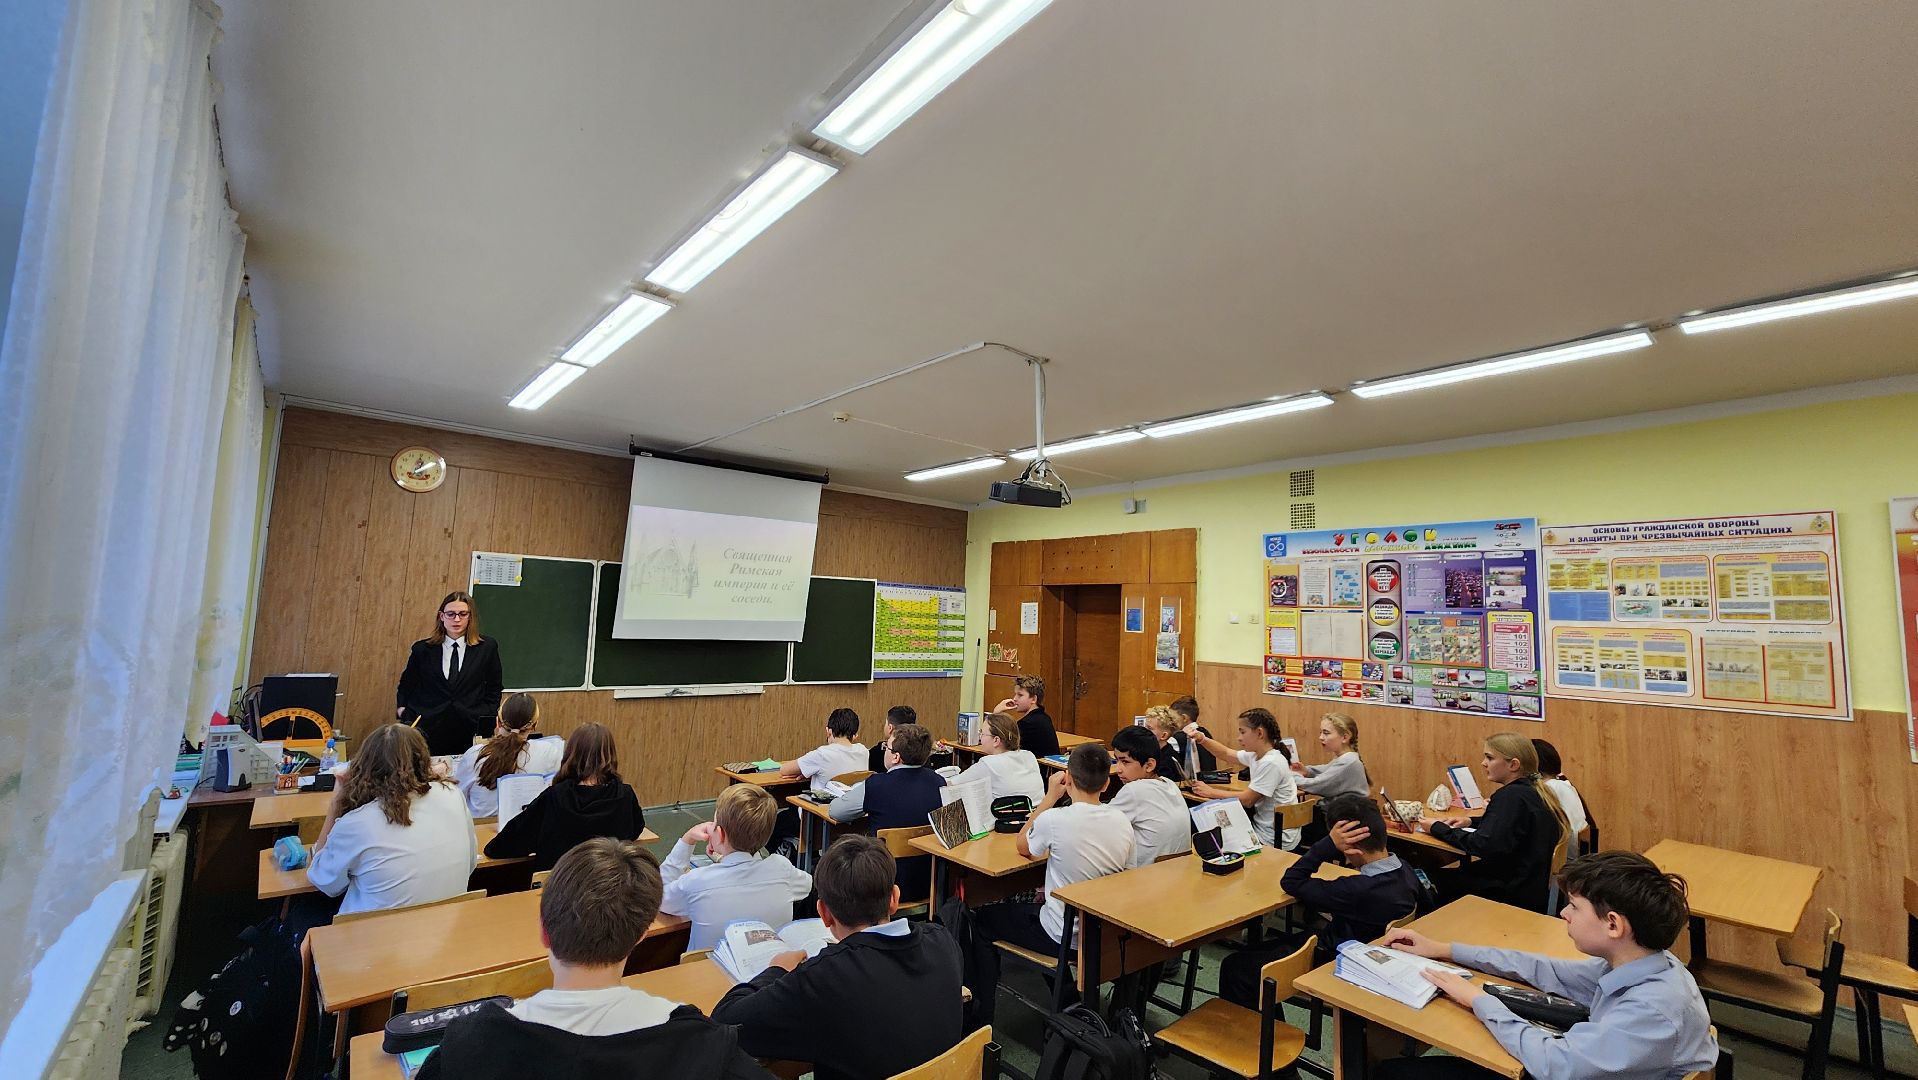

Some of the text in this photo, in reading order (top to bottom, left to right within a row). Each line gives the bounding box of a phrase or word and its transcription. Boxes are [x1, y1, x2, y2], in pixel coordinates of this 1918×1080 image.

[1592, 519, 1760, 534] ОСНОВЫ ГРАЖДАНСКОЙ ОБОРОНЫ
[1578, 535, 1617, 543] ЗАЩИТЫ
[1641, 528, 1724, 540] ЧРЕЗВЫЧАЙНЫХ
[1728, 527, 1792, 536] СИТУАЦИЯХ
[723, 547, 792, 563] Священная
[730, 563, 782, 576] Римская
[714, 580, 768, 591] империи
[771, 582, 779, 590] и
[731, 595, 773, 604] соседи.
